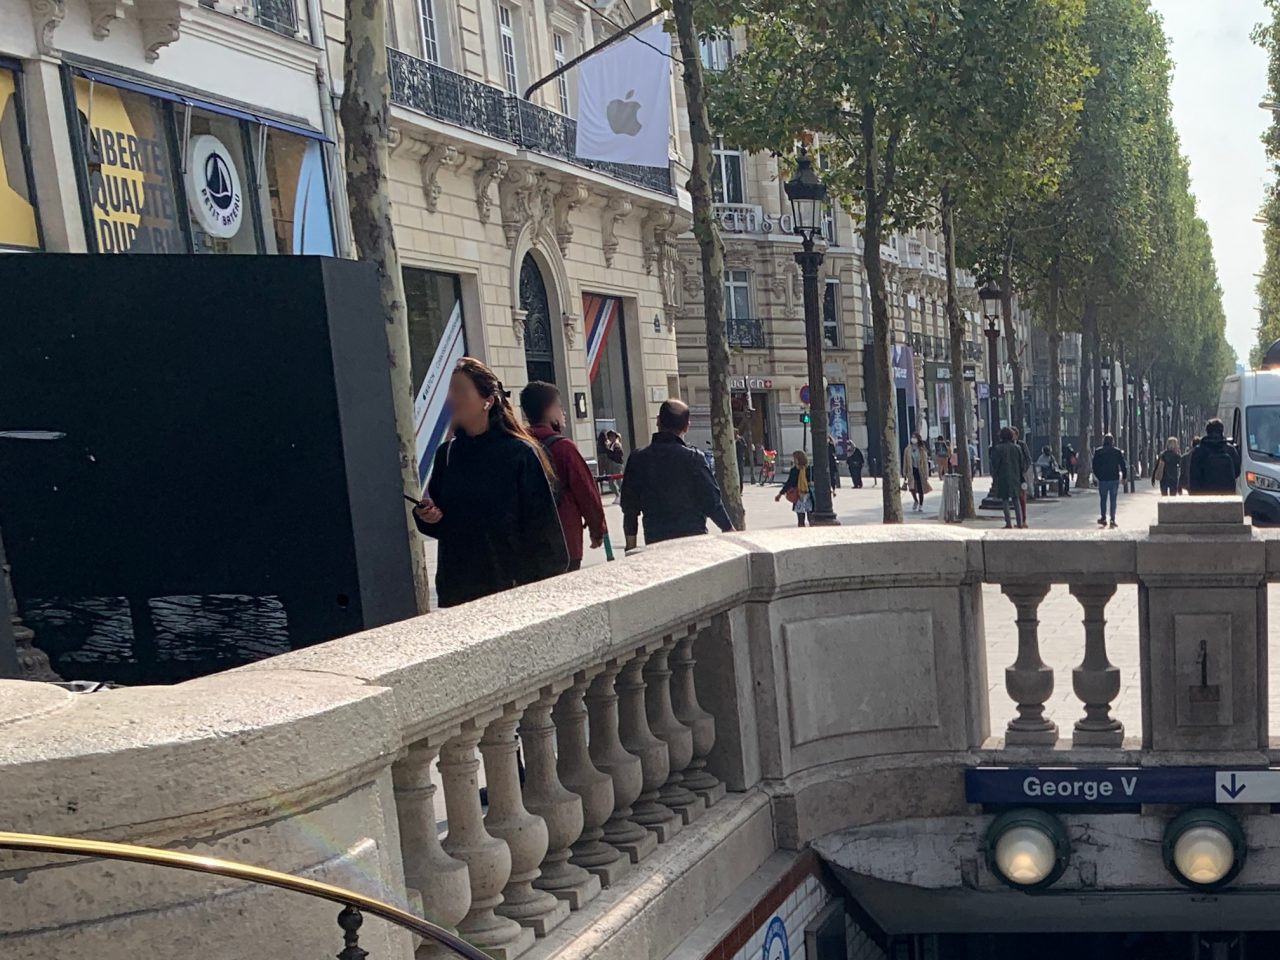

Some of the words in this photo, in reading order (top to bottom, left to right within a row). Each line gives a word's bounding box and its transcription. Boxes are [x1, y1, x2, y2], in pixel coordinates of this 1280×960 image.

[202, 189, 220, 221] PETIT
[222, 193, 241, 226] BATEAU
[1023, 776, 1113, 800] George
[1121, 776, 1137, 795] V
